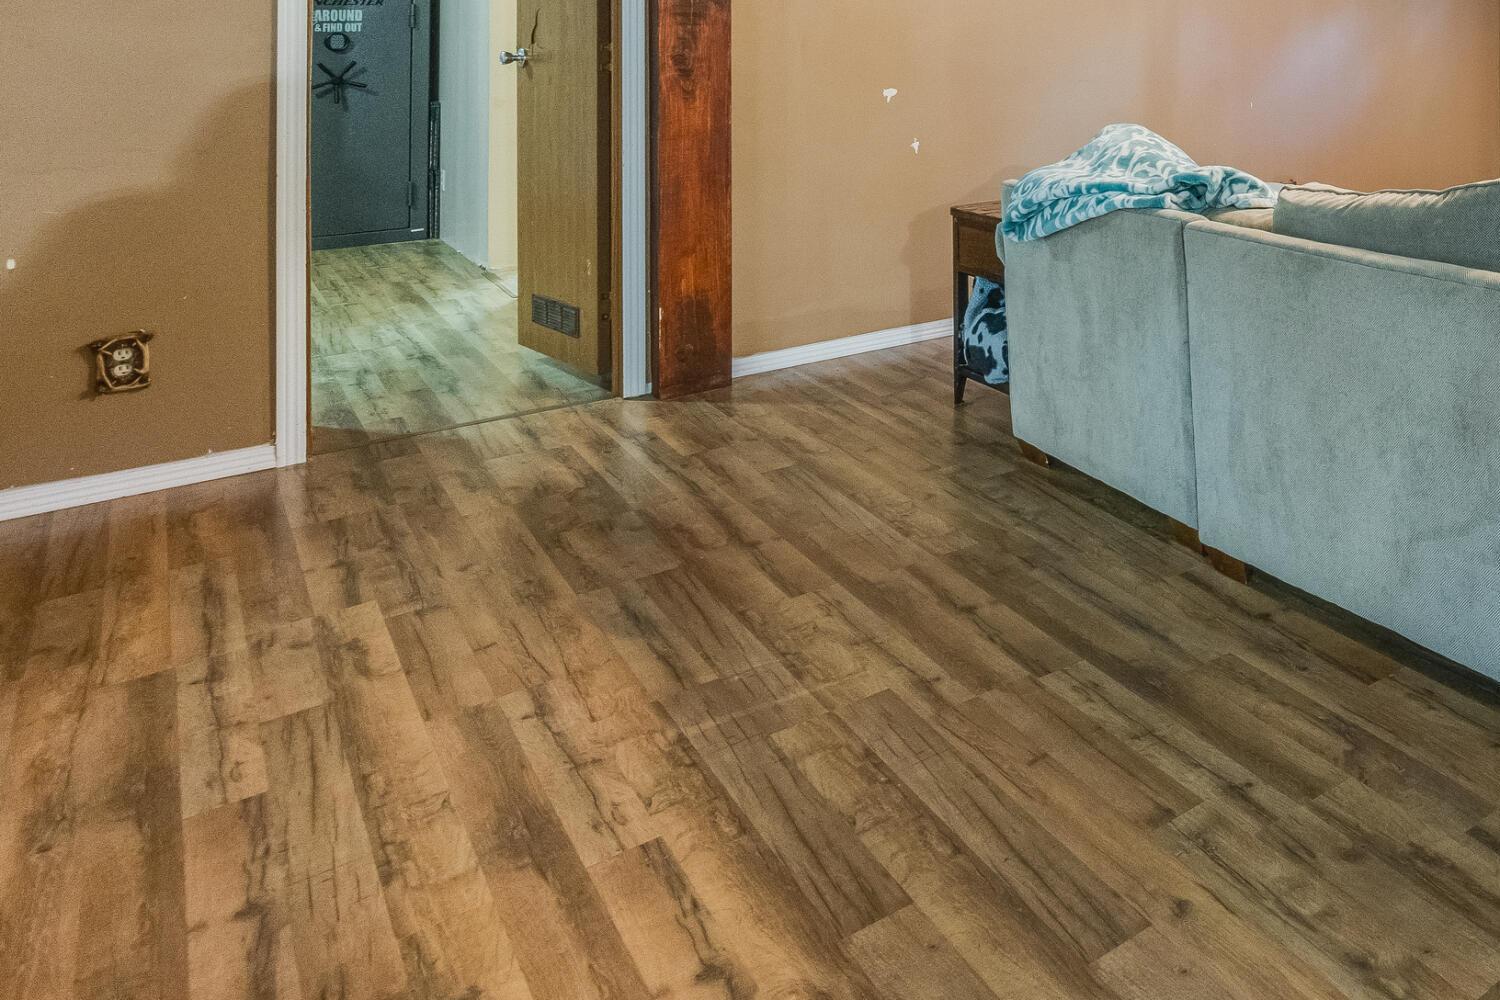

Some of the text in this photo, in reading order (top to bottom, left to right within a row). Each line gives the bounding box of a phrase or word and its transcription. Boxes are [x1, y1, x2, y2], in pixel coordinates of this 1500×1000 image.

[314, 9, 363, 22] AROUND
[314, 22, 363, 32] & FIND OUT
